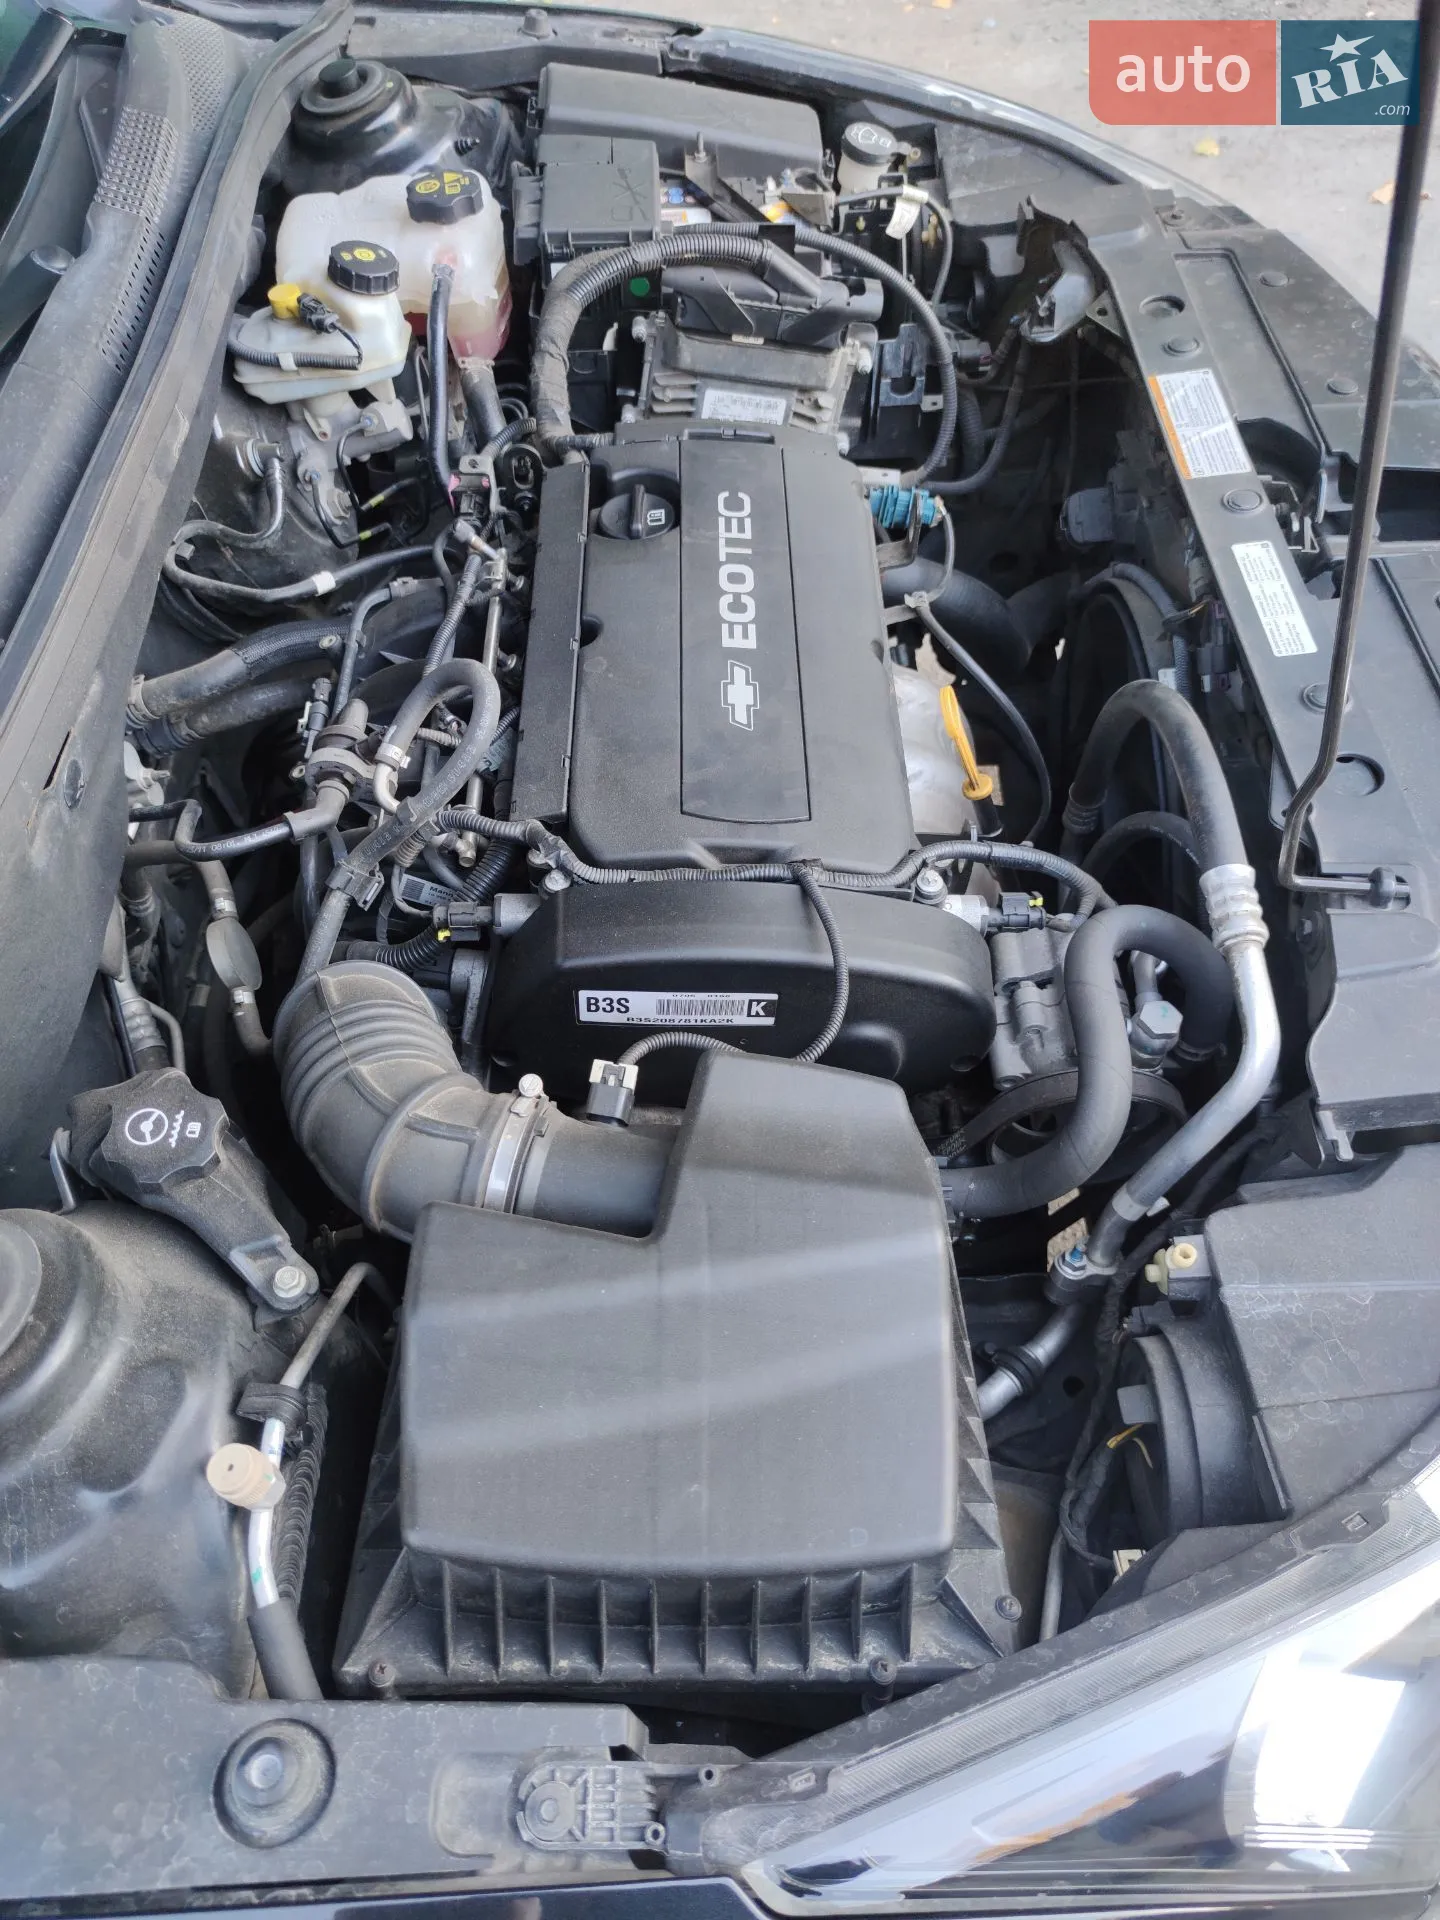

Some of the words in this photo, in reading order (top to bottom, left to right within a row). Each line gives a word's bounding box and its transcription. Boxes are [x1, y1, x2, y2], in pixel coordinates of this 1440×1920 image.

[717, 490, 757, 649] ECOTEC
[586, 996, 630, 1014] B3S
[750, 1001, 767, 1016] K
